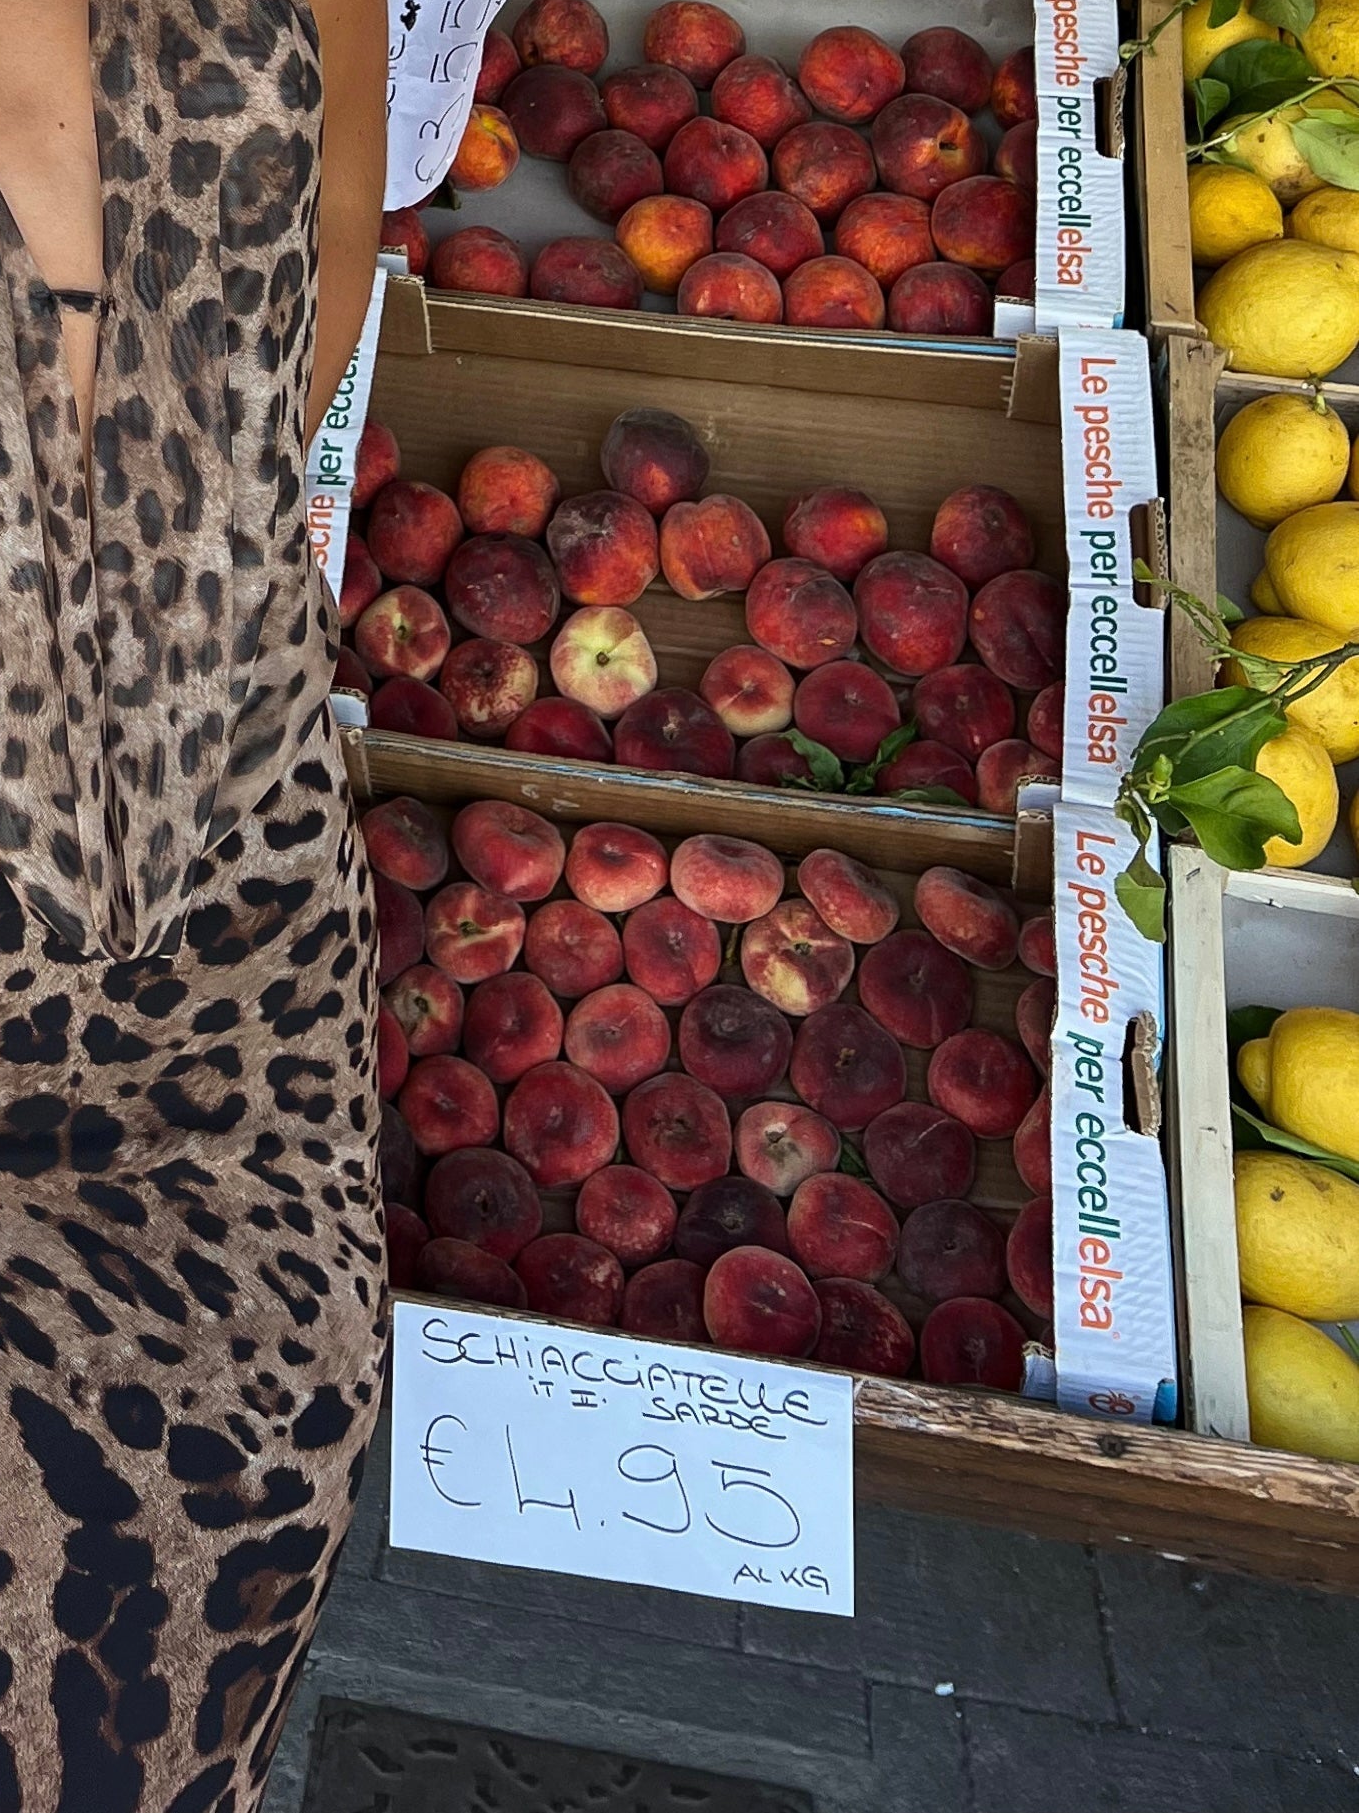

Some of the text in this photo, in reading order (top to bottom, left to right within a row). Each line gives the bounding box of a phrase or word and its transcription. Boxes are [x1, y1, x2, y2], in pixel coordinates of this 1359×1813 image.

[1057, 95, 1082, 140] per
[1057, 146, 1091, 286] eccellelsa
[316, 437, 347, 486] per
[1073, 357, 1127, 765] Le pesche per eccellelsa
[1066, 830, 1124, 1331] Le pesche per eccellelsa
[641, 1396, 787, 1441] SARDE
[732, 1562, 831, 1596] AL KG
